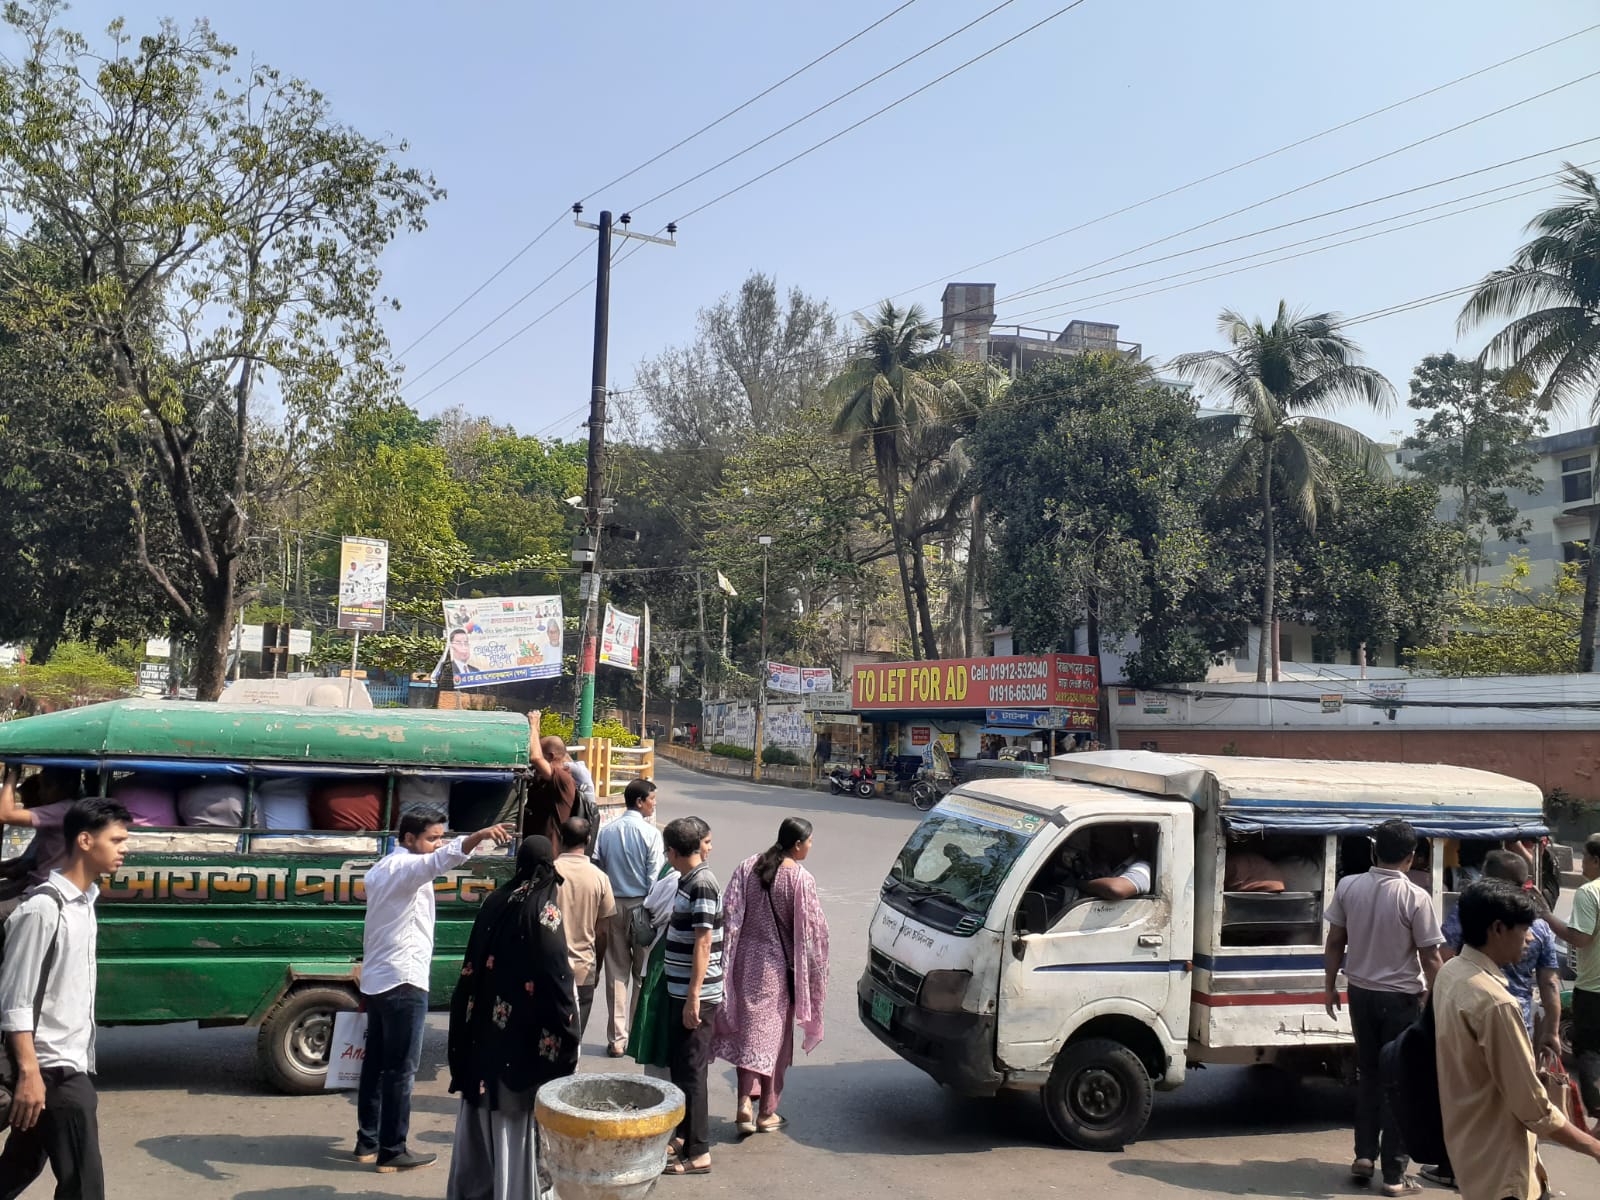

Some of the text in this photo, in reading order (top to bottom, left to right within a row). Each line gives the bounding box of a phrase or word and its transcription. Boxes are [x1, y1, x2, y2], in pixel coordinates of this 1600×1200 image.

[857, 669, 876, 702] TO
[879, 668, 907, 702] LET
[910, 667, 941, 701] FOR
[944, 665, 968, 701] AD
[971, 664, 988, 681] Cell:
[990, 661, 1048, 680] 01912-532940
[989, 683, 1048, 702] 01916-663046
